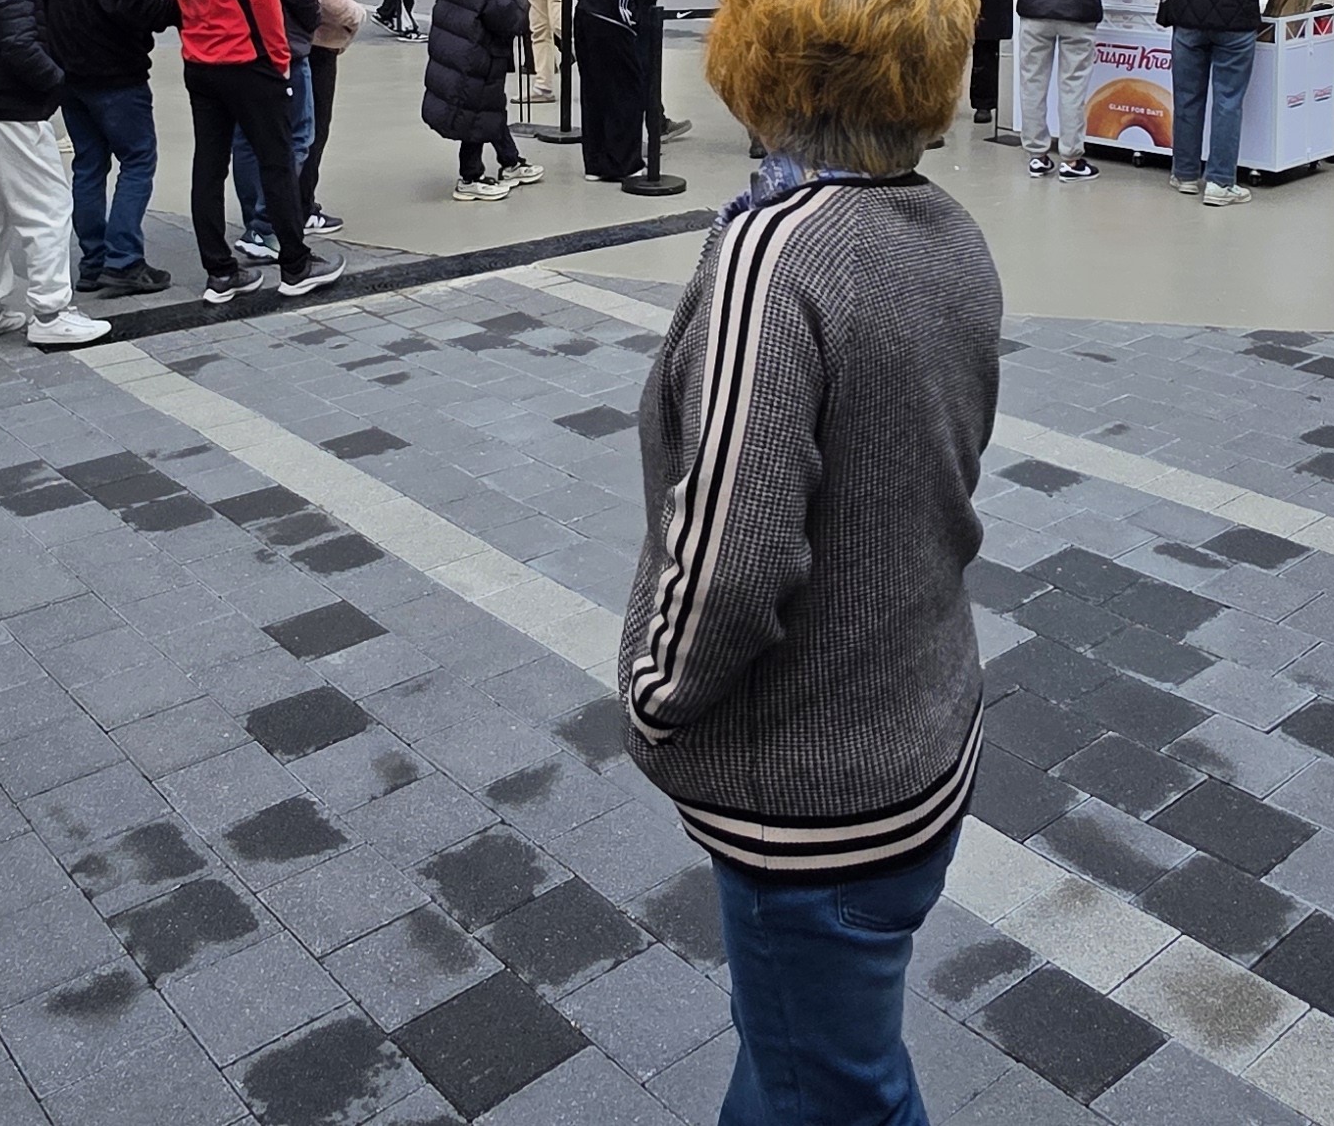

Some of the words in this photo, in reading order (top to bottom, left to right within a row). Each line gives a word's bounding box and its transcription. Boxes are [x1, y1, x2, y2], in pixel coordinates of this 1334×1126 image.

[1095, 42, 1139, 71] rispy
[1108, 102, 1130, 113] GLAZE
[1130, 105, 1145, 115] FOR
[1146, 107, 1164, 117] DAYS
